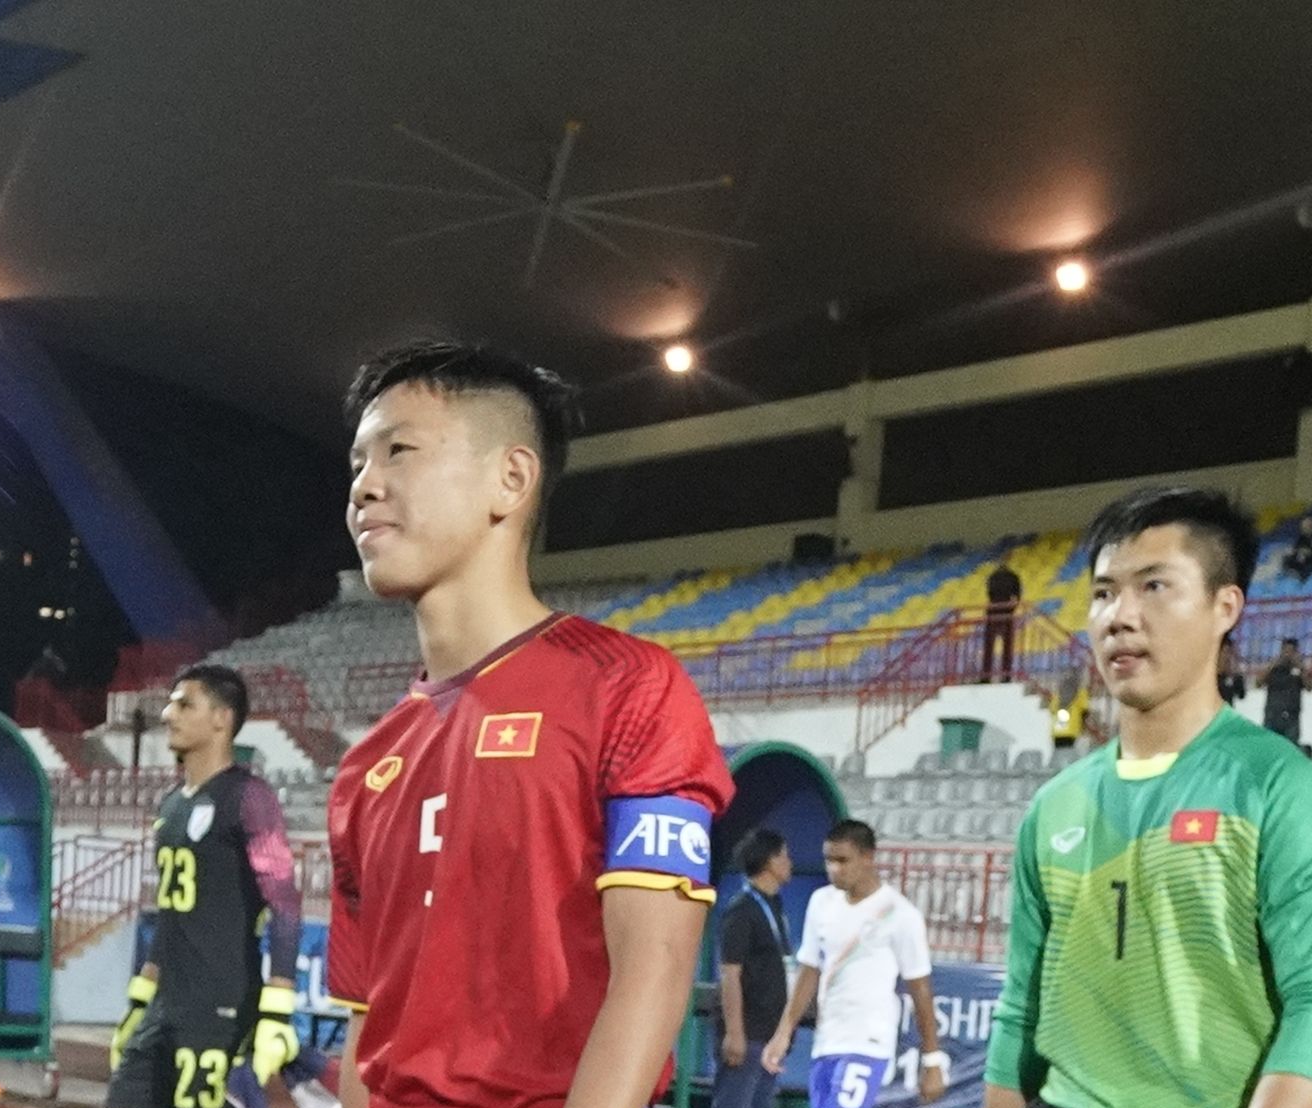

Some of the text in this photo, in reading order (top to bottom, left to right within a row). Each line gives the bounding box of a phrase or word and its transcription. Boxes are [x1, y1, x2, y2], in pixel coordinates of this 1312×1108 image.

[616, 812, 711, 865] AFC
[157, 847, 197, 912] 23
[1111, 879, 1128, 960] 1
